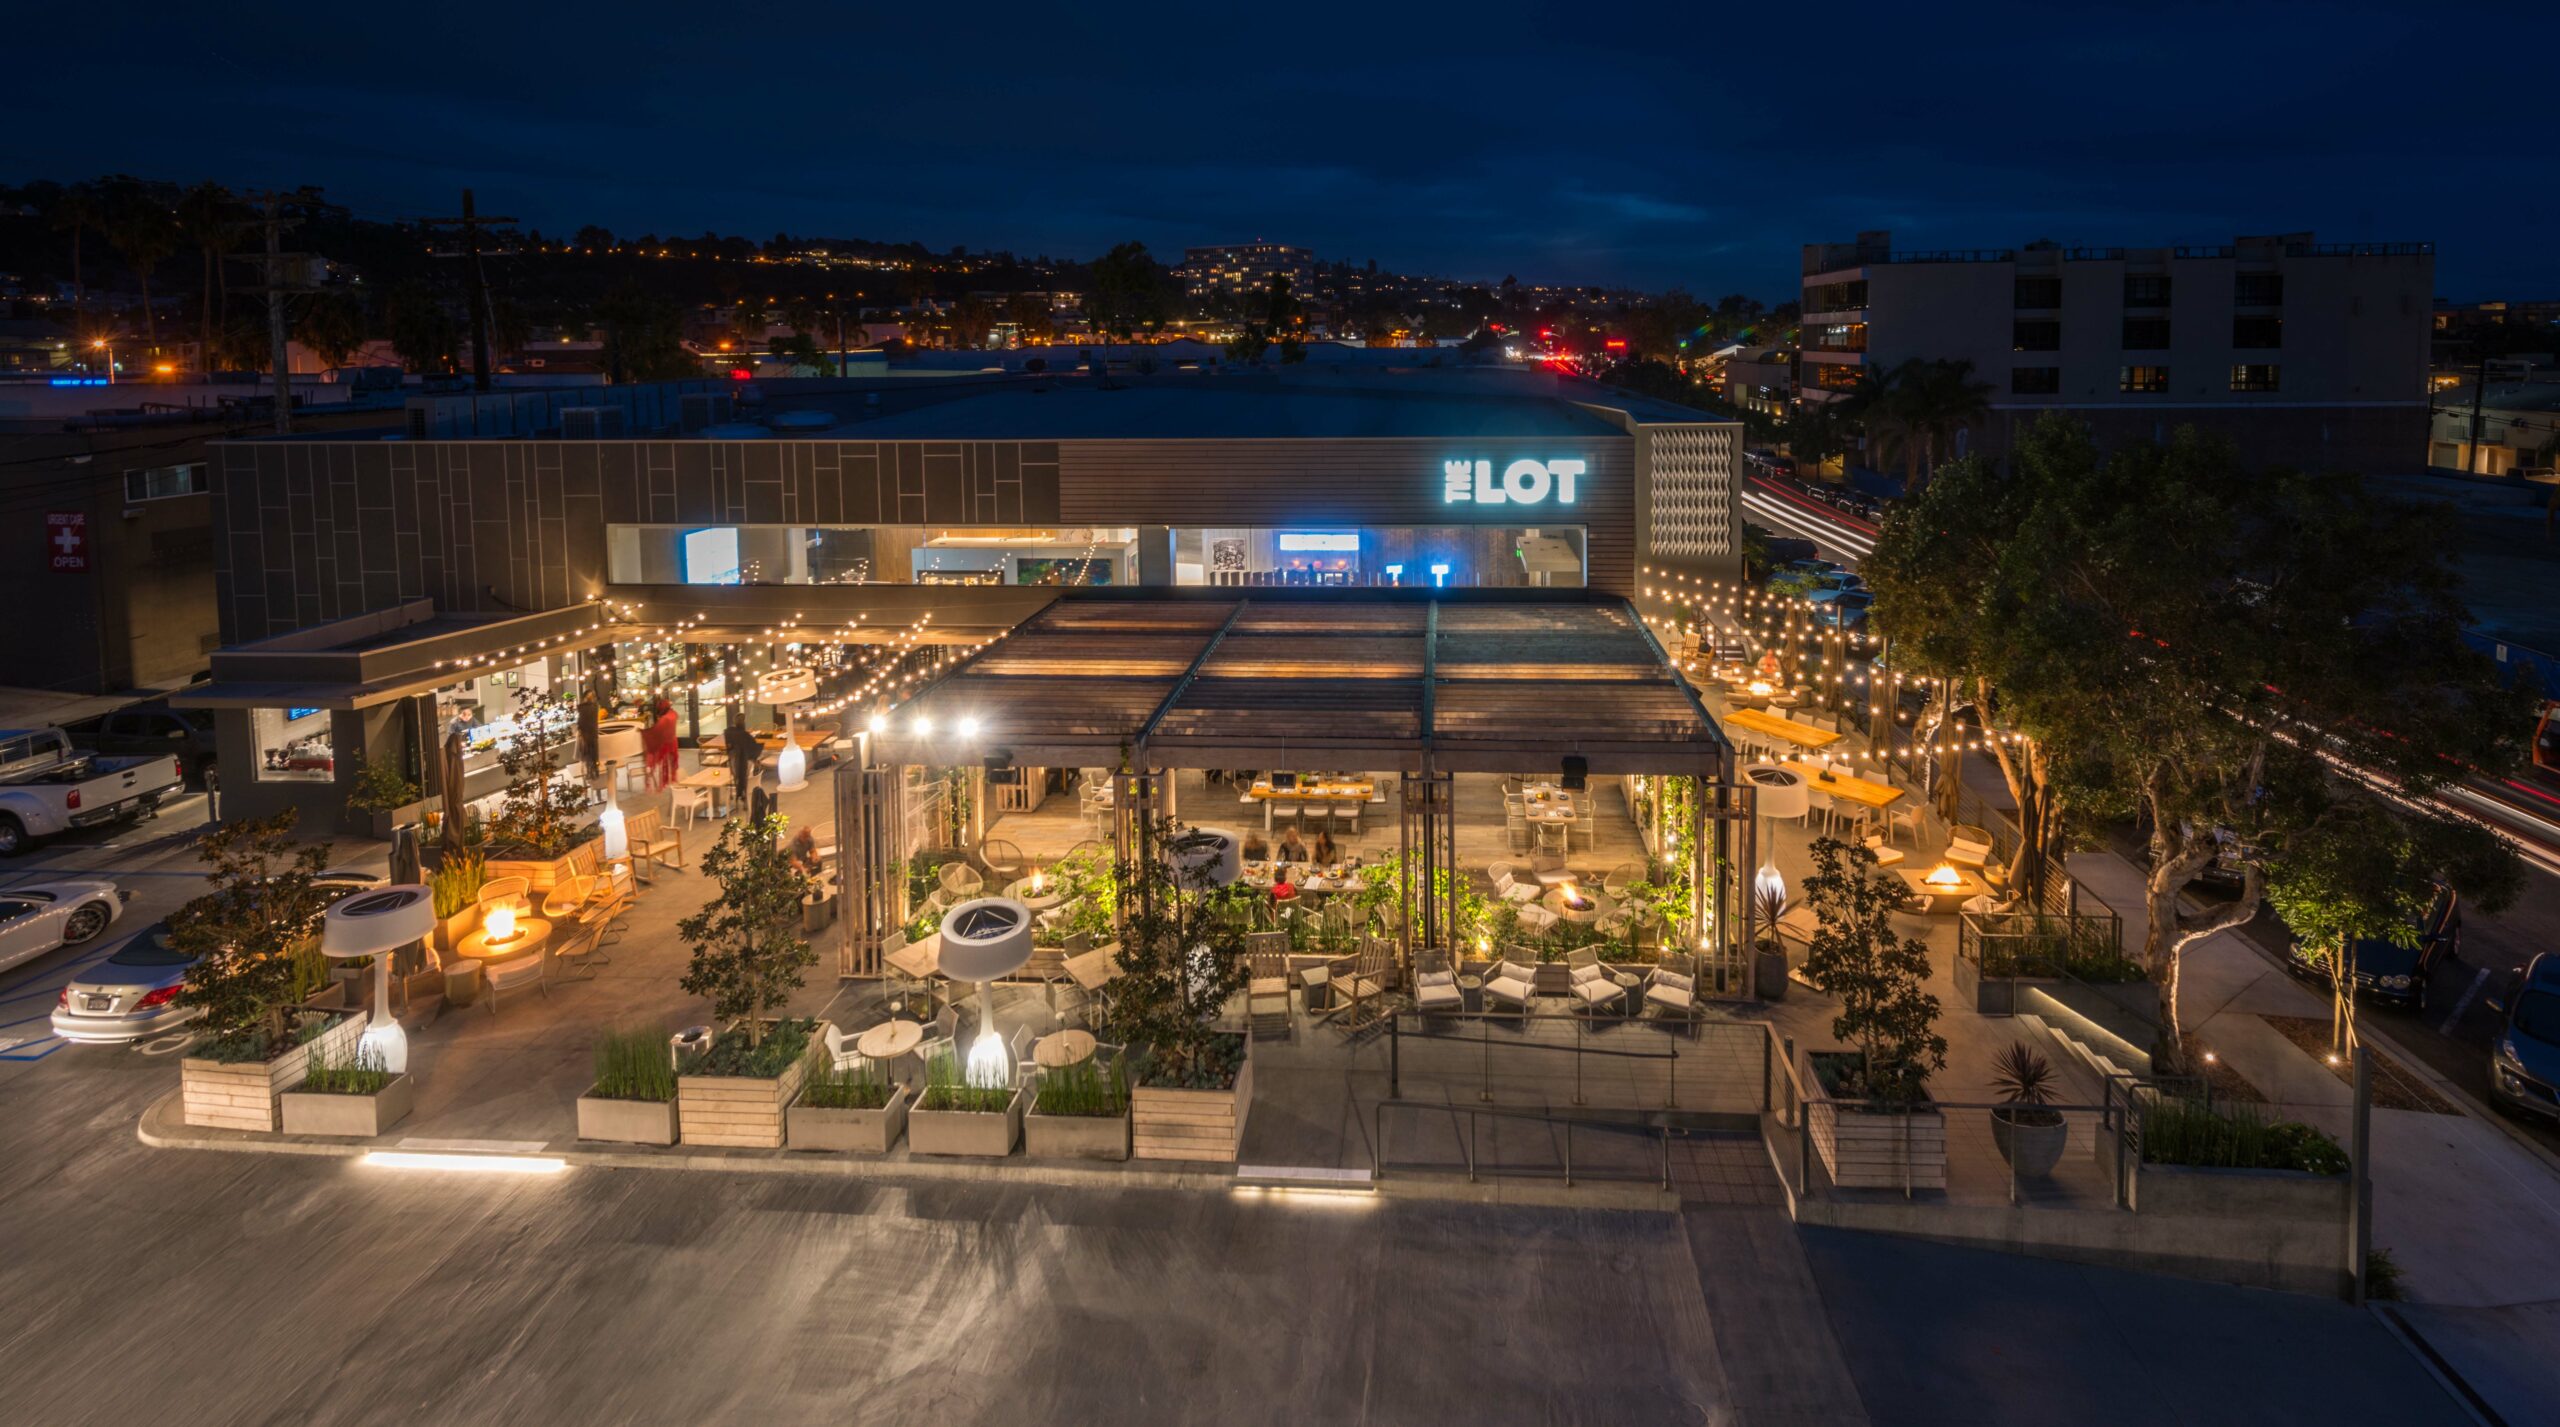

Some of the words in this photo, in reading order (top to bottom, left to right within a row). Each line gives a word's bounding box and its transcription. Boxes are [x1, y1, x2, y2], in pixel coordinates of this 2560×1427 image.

[1445, 461, 1471, 503] THE
[1475, 459, 1585, 504] LOT
[54, 556, 84, 568] OPEN
